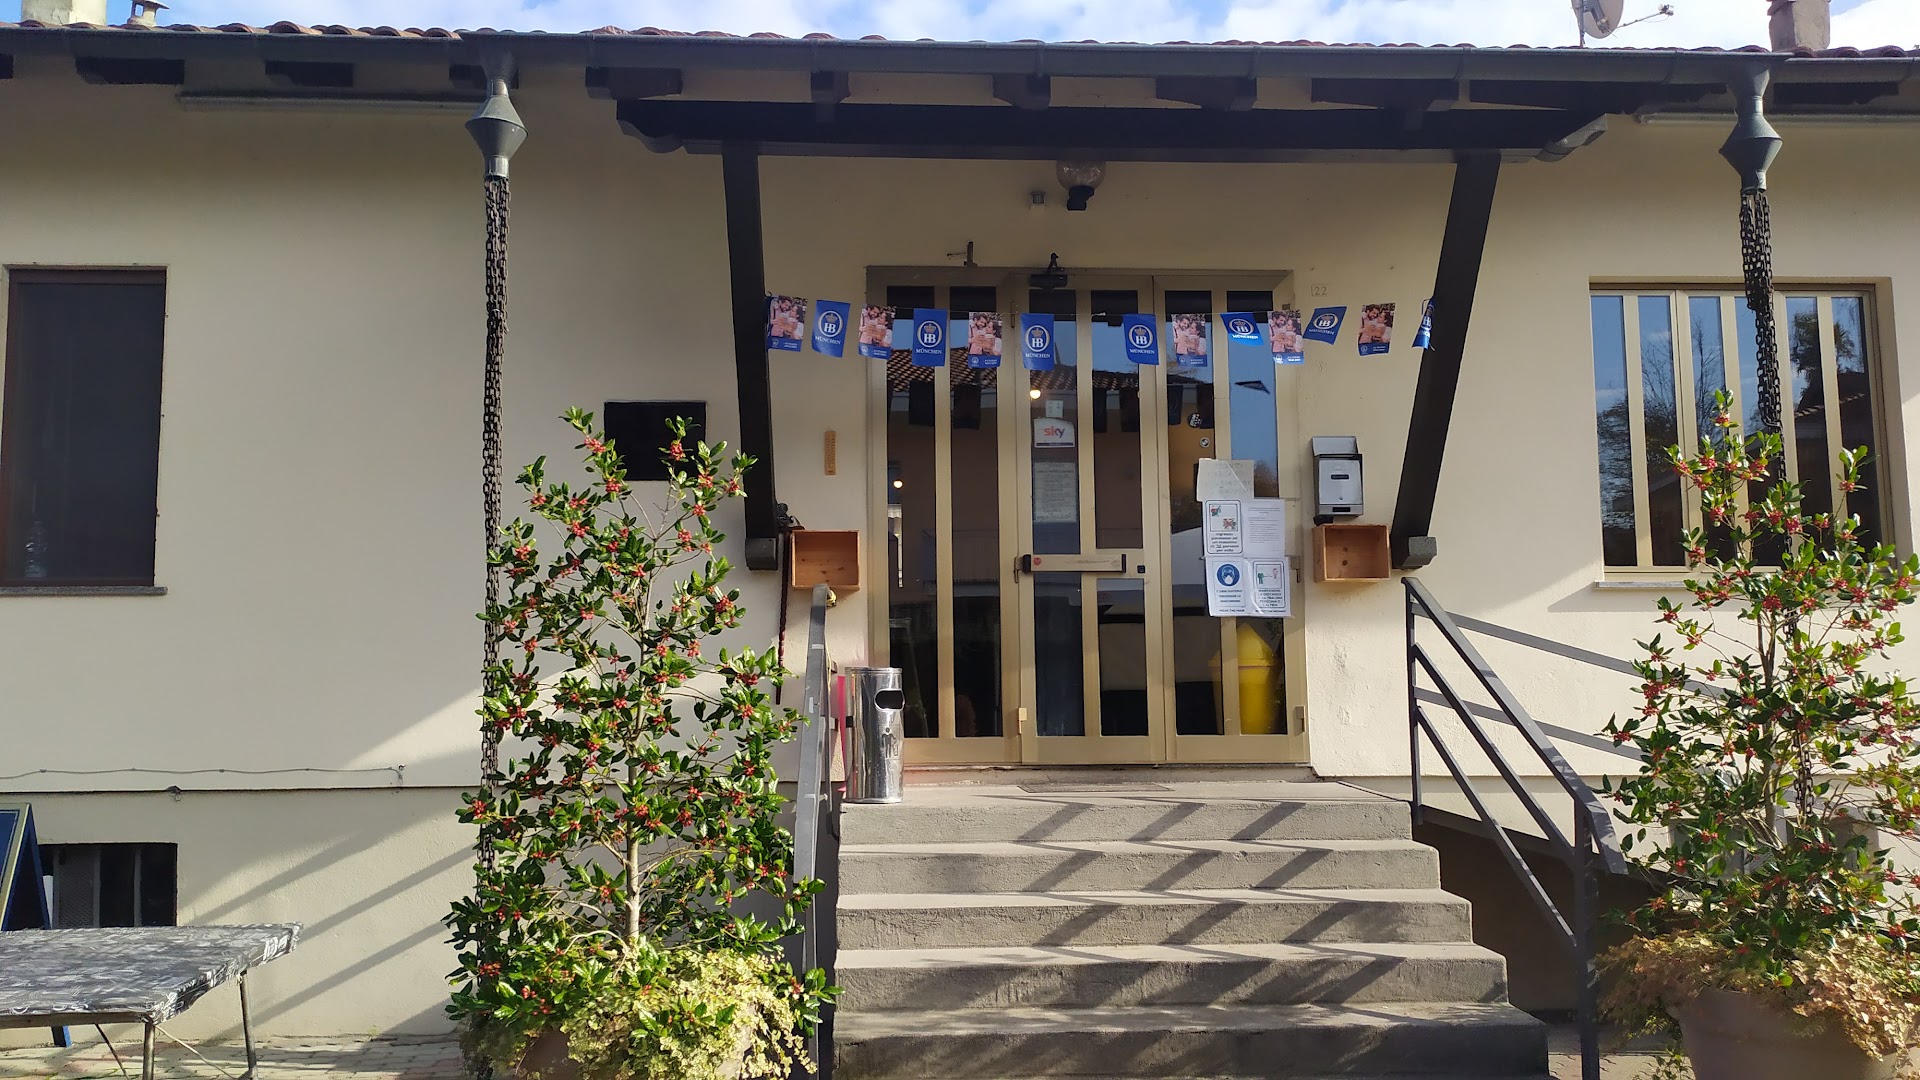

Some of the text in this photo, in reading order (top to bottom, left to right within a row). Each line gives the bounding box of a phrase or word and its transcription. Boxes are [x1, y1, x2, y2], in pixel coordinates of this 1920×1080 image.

[1314, 286, 1327, 296] 22
[824, 322, 836, 334] HB
[814, 334, 842, 346] MÜNCHEN
[924, 333, 936, 343] HB
[1032, 338, 1044, 348] HB
[1135, 335, 1148, 345] HB
[915, 347, 943, 355] MÜNCHEN
[1025, 351, 1051, 360] MÜNCHEN
[1043, 426, 1066, 439] sky
